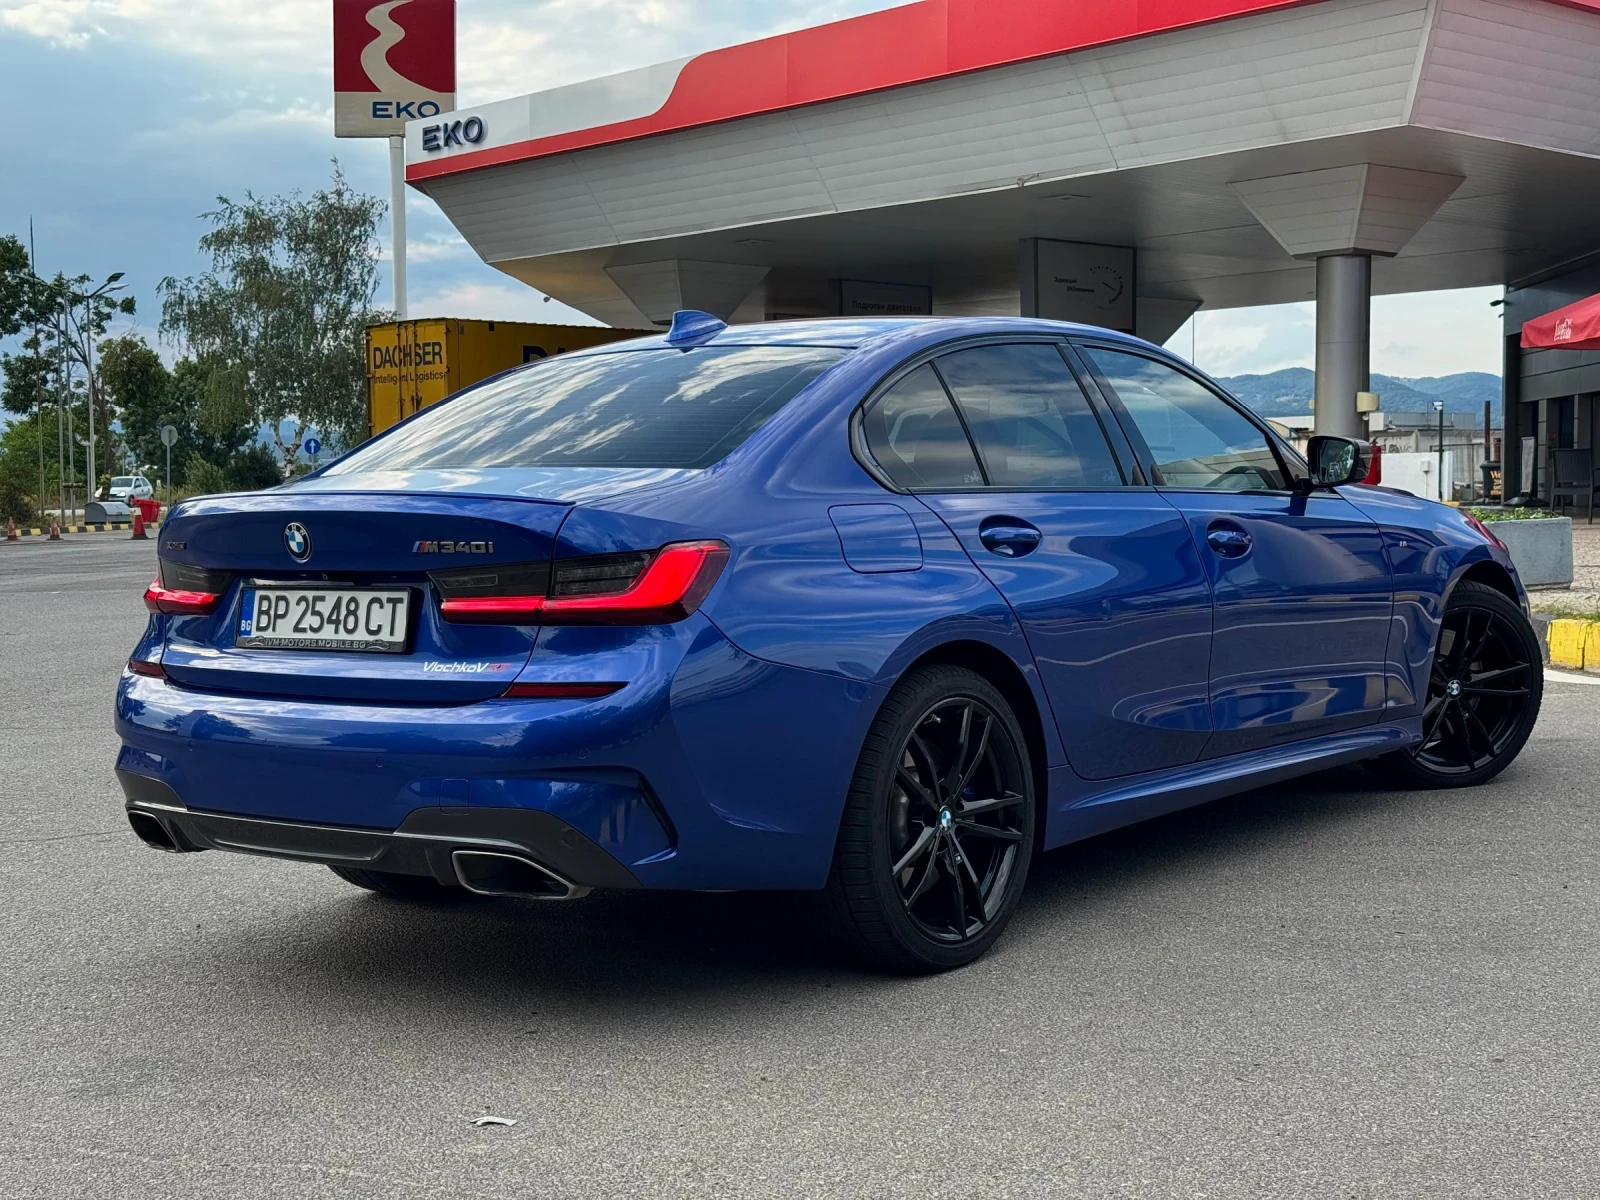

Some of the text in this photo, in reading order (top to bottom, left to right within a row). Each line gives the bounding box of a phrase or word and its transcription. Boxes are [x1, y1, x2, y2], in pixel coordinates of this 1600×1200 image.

[372, 100, 440, 118] EKO
[422, 115, 484, 151] EKO
[373, 341, 443, 369] DACHSER
[374, 373, 408, 385] Intellignt
[423, 541, 494, 554] M340i
[255, 594, 404, 636] BP 2548 CT
[240, 619, 251, 631] BG
